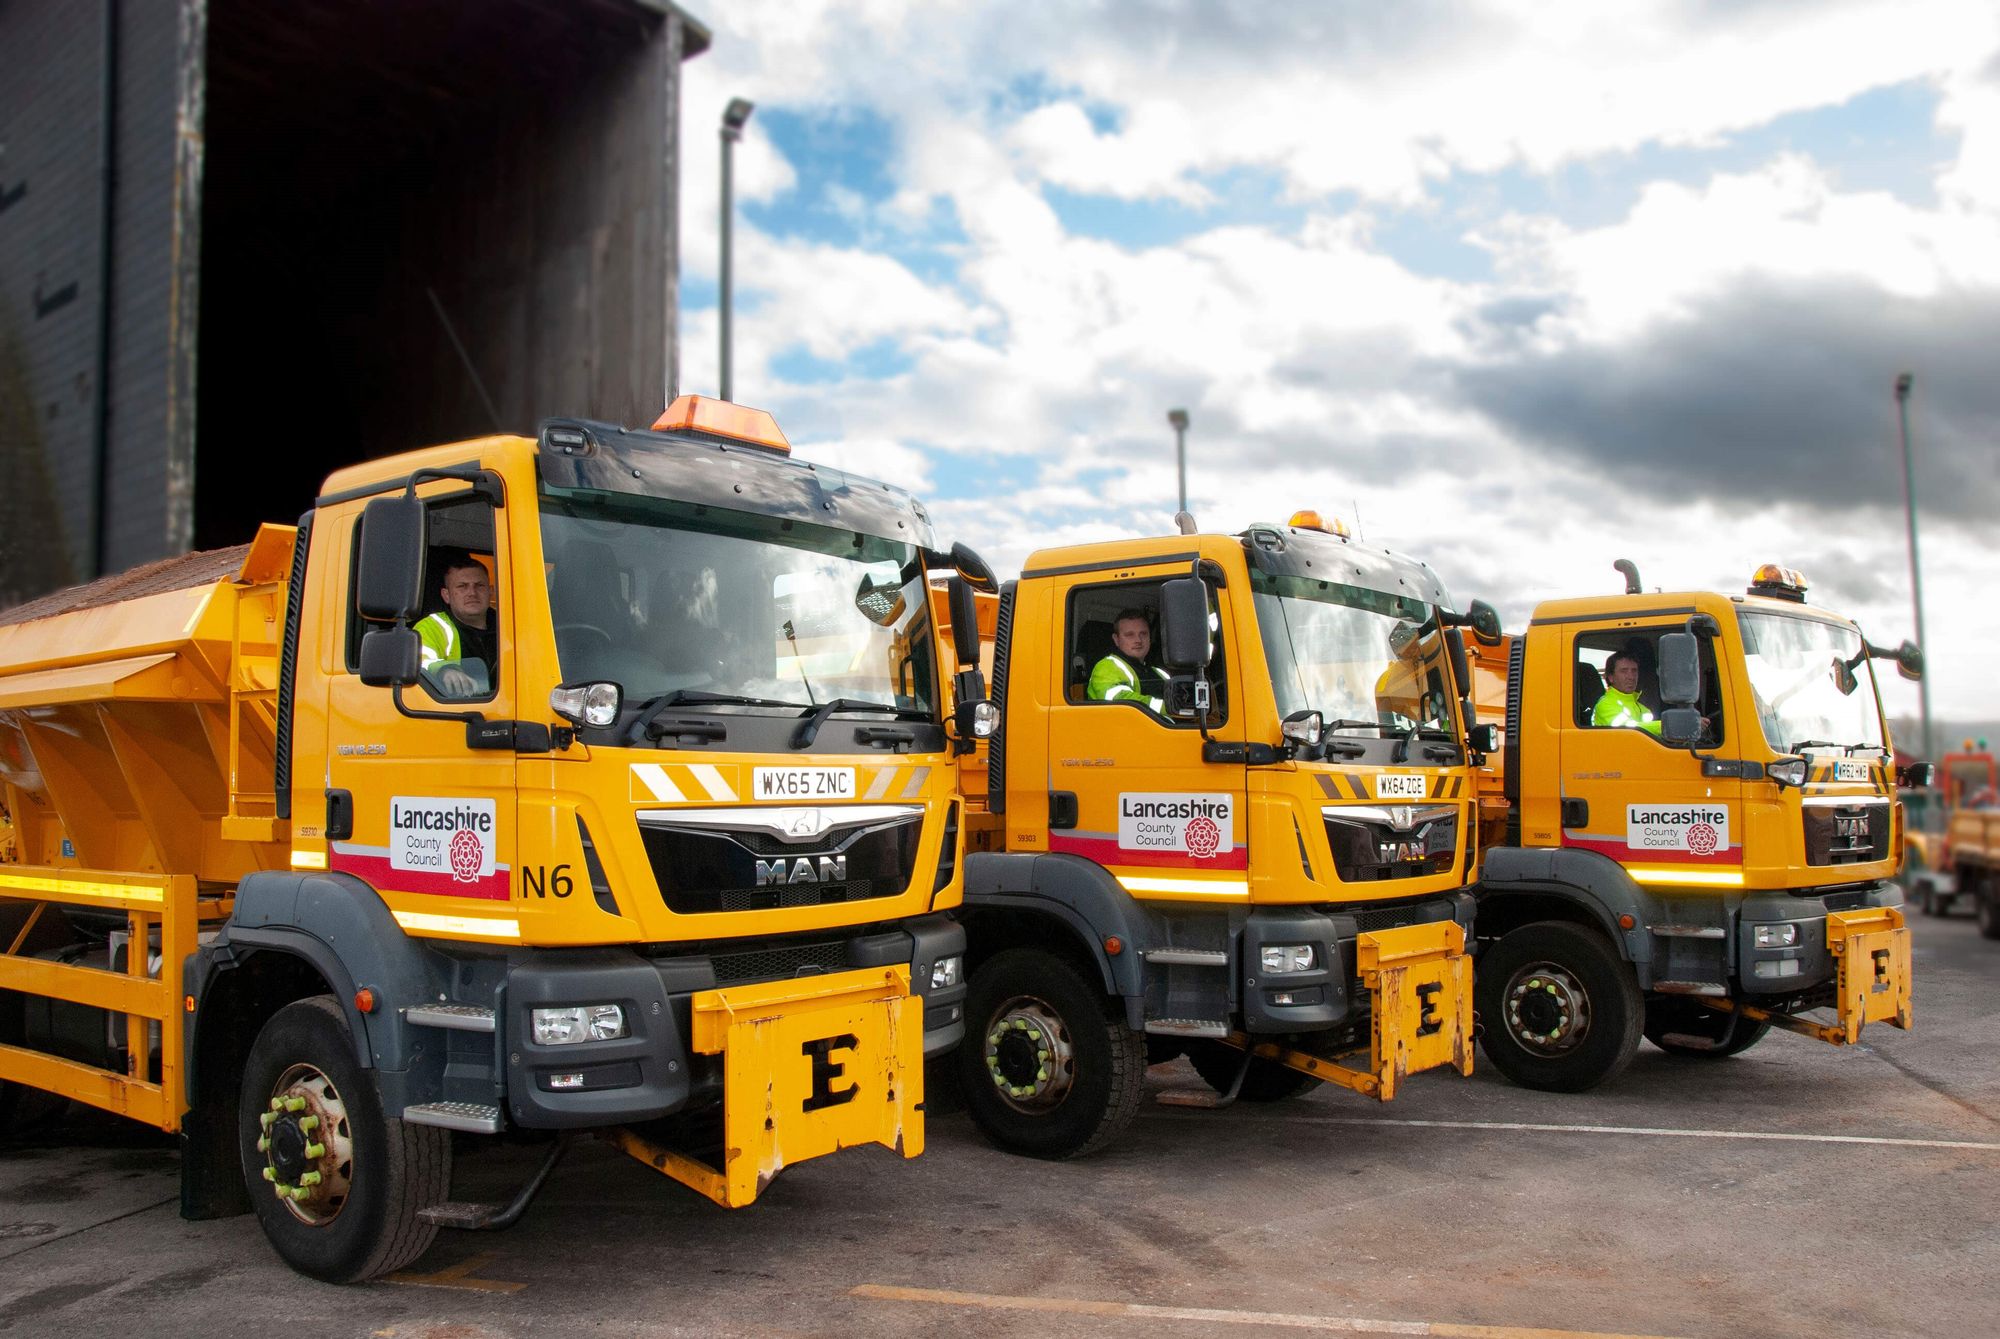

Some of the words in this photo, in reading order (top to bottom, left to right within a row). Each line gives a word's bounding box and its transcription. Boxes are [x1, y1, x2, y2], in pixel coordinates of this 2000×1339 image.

[763, 772, 810, 795] WX65
[816, 772, 847, 794] ZNC
[1380, 777, 1404, 794] WX64
[1407, 777, 1422, 794] ZGE
[394, 804, 491, 832] Lancashire
[1122, 798, 1229, 819] Lancashire
[1631, 809, 1725, 825] Lancashire
[1136, 822, 1175, 835] County
[1644, 827, 1678, 837] County
[1837, 819, 1869, 836] MAN
[406, 835, 441, 852] County
[1135, 834, 1177, 846] Council
[1643, 837, 1680, 847] Council
[405, 851, 442, 866] Council
[1380, 842, 1425, 863] MAN
[756, 855, 846, 886] MAN
[523, 864, 573, 899] N6
[1871, 949, 1890, 993] E
[1416, 981, 1444, 1038] E
[802, 1033, 860, 1113] E
